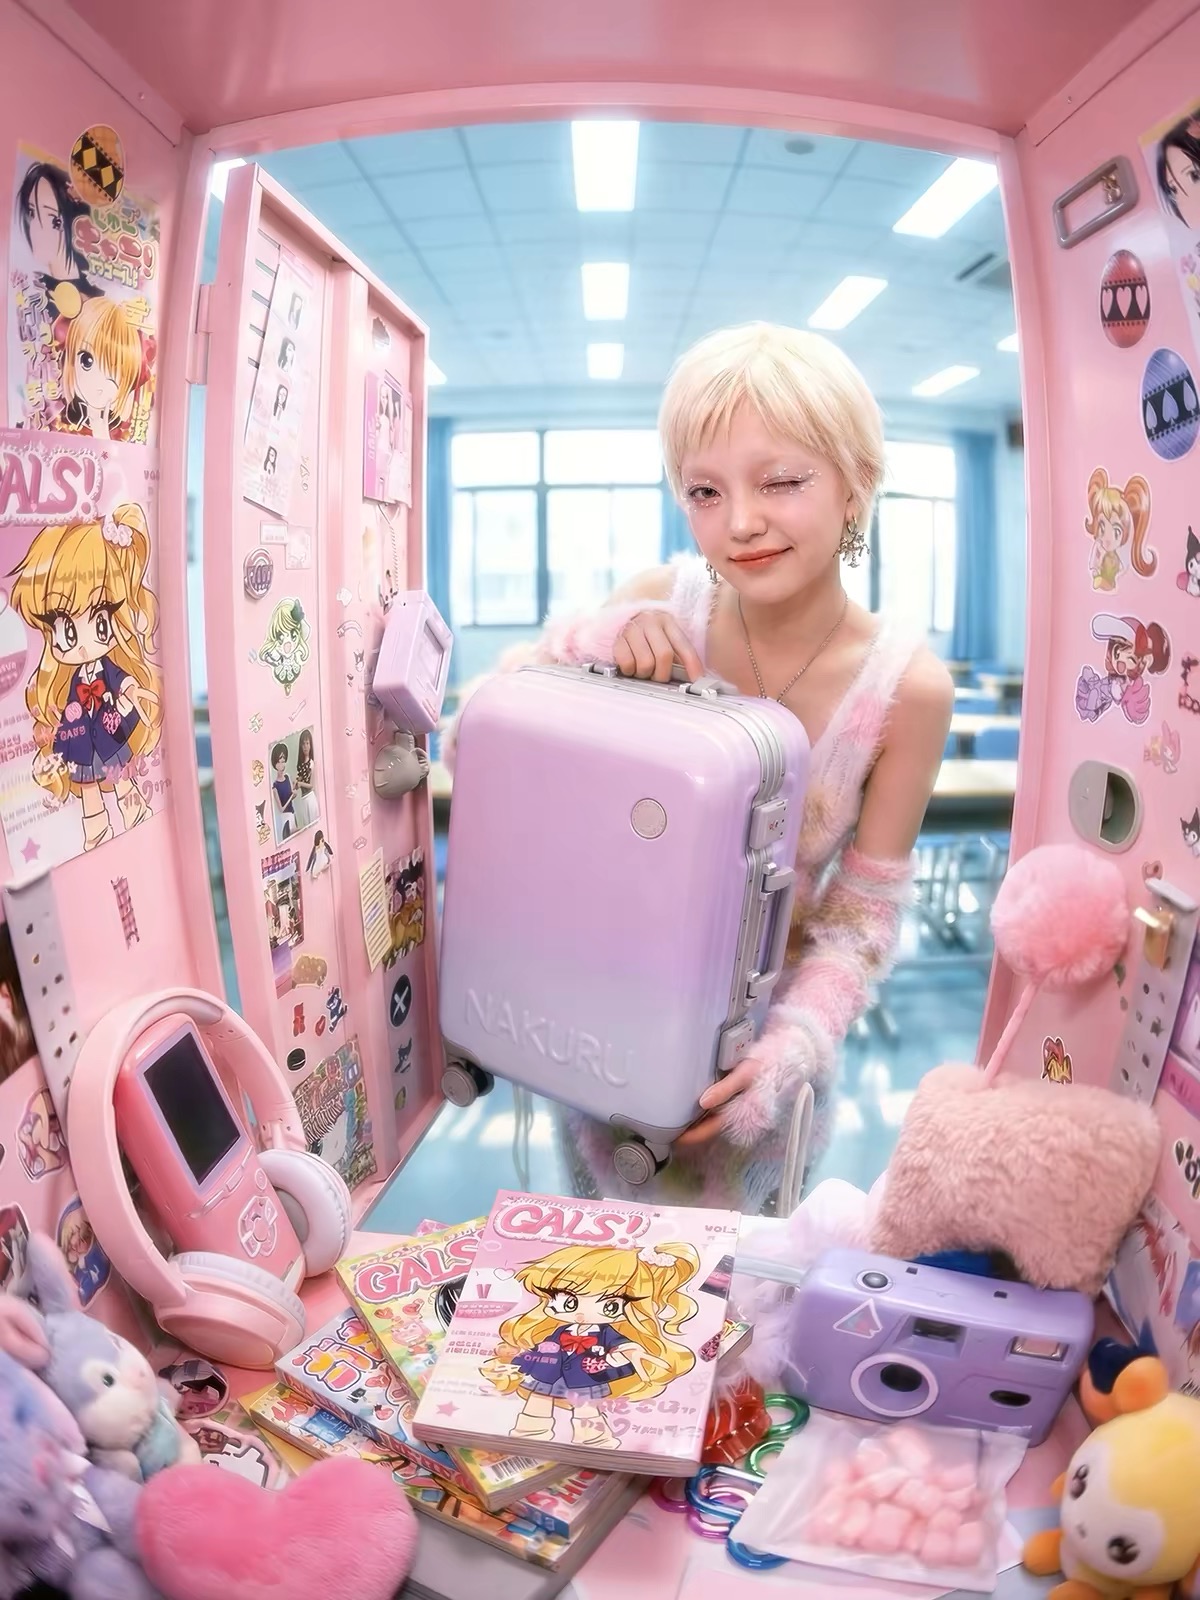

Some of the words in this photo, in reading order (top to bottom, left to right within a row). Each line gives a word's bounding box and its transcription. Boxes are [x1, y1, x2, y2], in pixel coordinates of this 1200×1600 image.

[0, 455, 96, 515] ALS!
[464, 988, 635, 1088] NAKURU
[499, 1203, 644, 1245] GALS!
